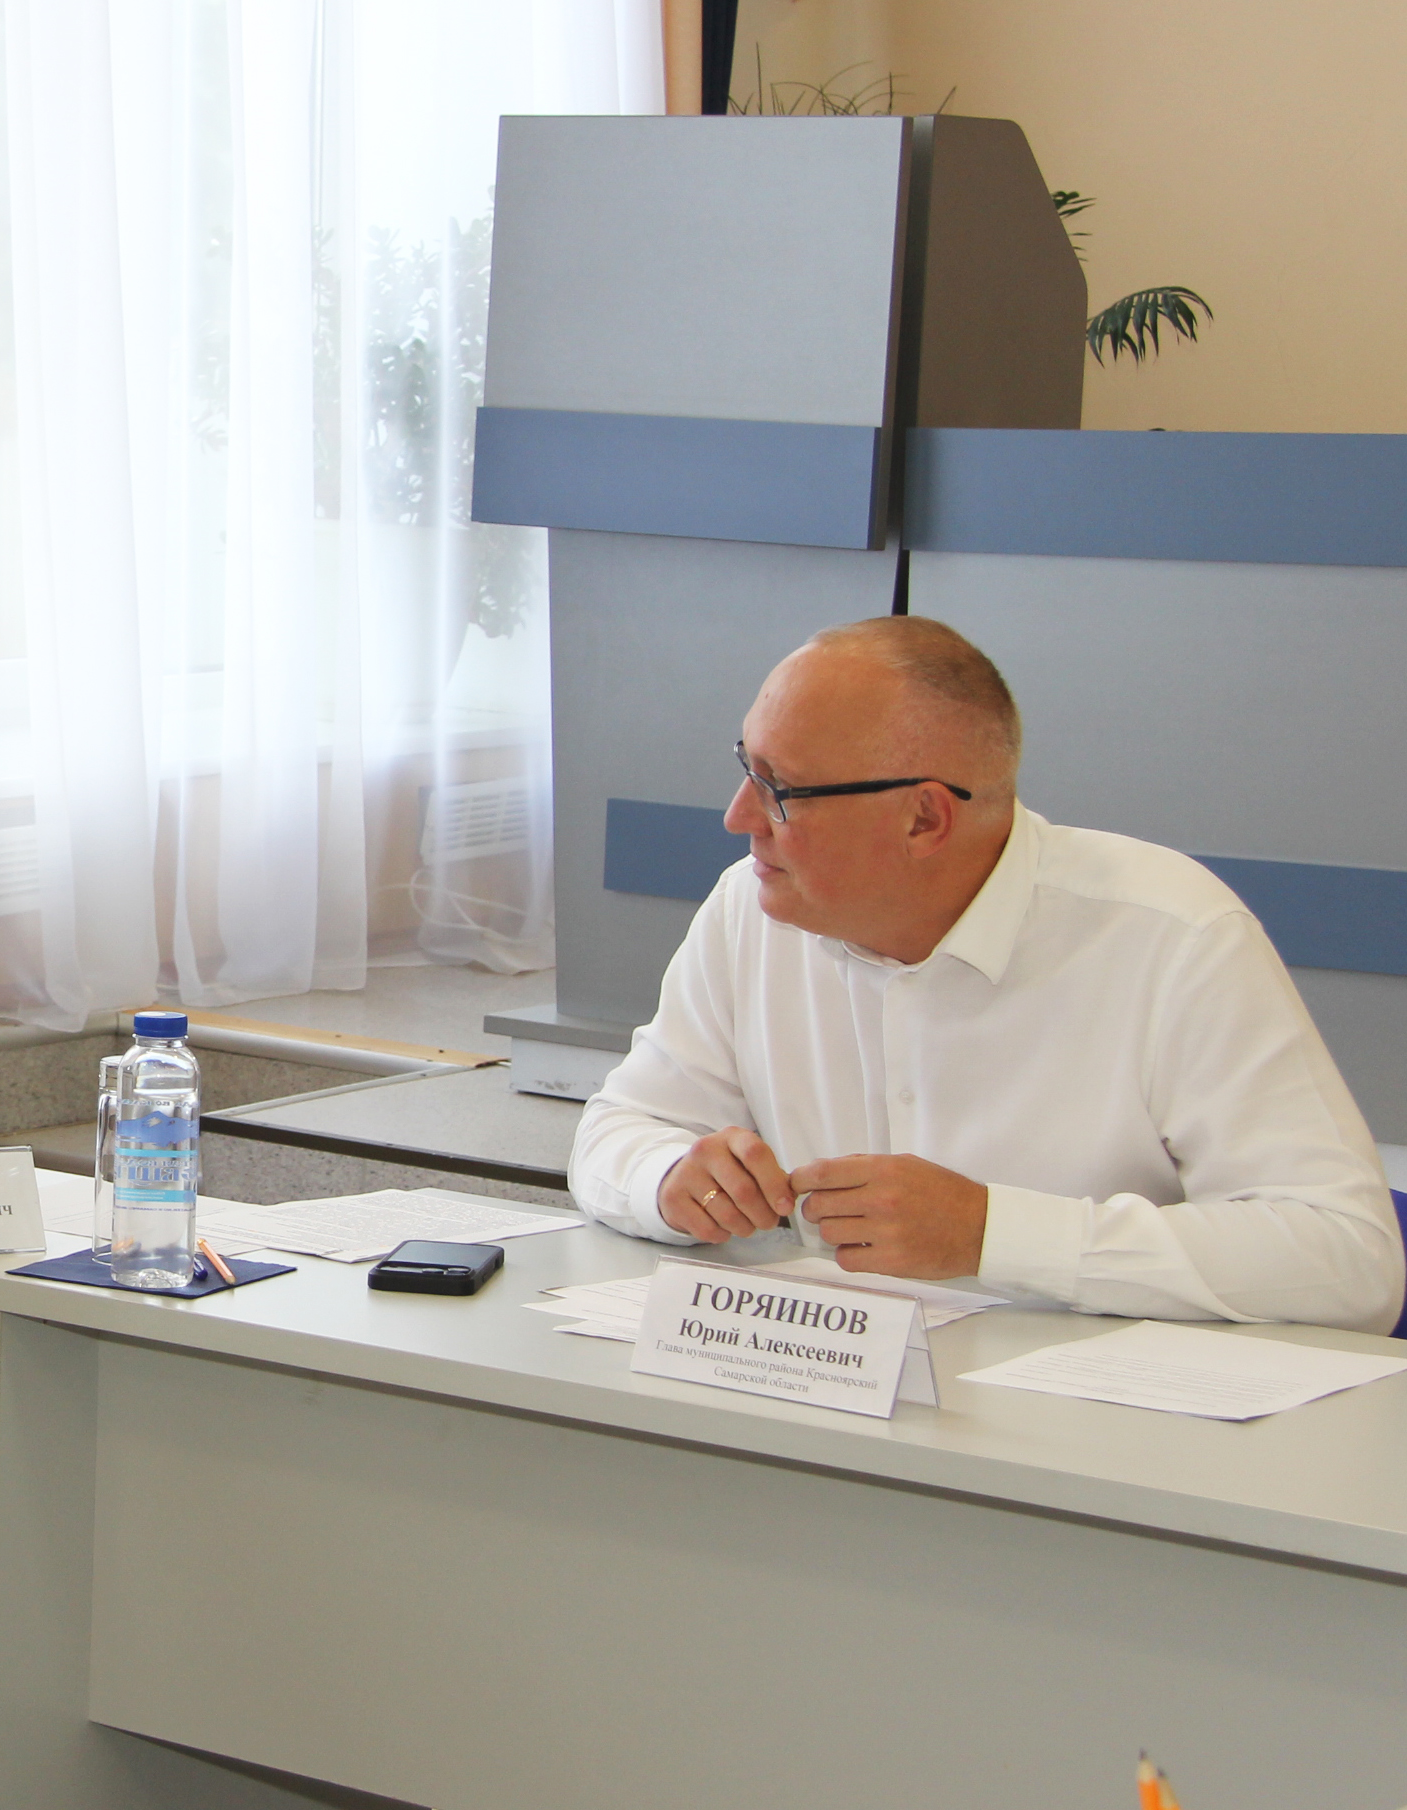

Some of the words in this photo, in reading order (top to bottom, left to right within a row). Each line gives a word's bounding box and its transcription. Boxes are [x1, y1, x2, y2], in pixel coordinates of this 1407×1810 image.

[691, 1283, 867, 1334] ГОРЯИНОВ
[656, 1339, 683, 1355] Глава
[686, 1347, 767, 1370] муниципального
[769, 1362, 803, 1377] района
[806, 1366, 877, 1391] Красноярский
[679, 1319, 739, 1345] Юрий
[744, 1332, 863, 1368] Алексеевич
[714, 1365, 767, 1386] Самарской
[769, 1376, 809, 1394] области
